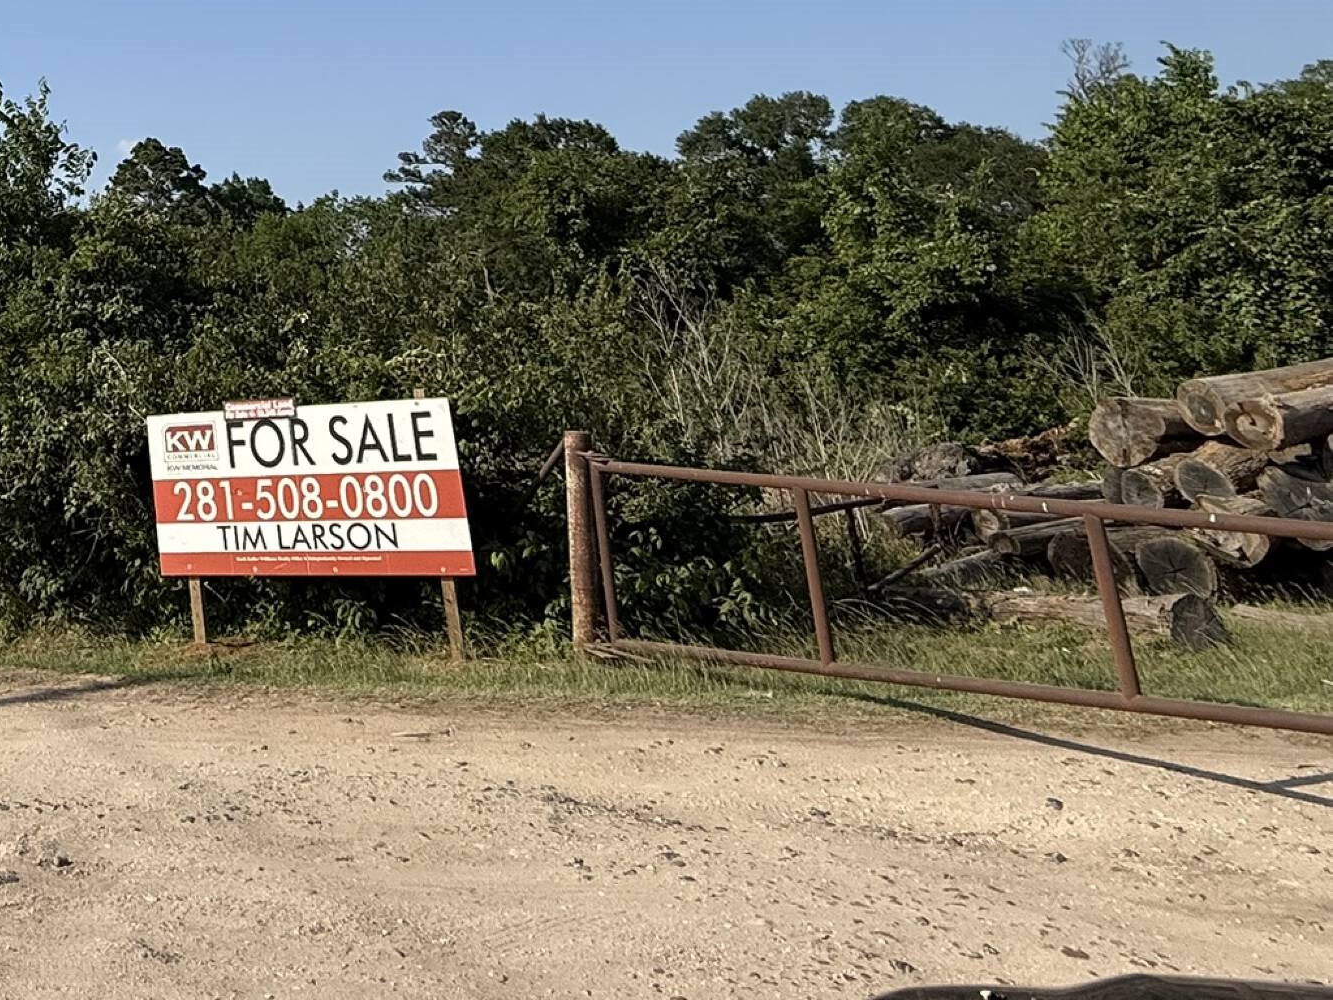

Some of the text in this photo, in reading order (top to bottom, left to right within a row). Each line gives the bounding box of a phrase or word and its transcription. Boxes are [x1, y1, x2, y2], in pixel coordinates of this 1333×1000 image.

[166, 430, 213, 451] KW
[226, 411, 438, 469] FOR SALE
[173, 473, 438, 521] 281-508-0800
[216, 522, 399, 550] TIM LARSON
